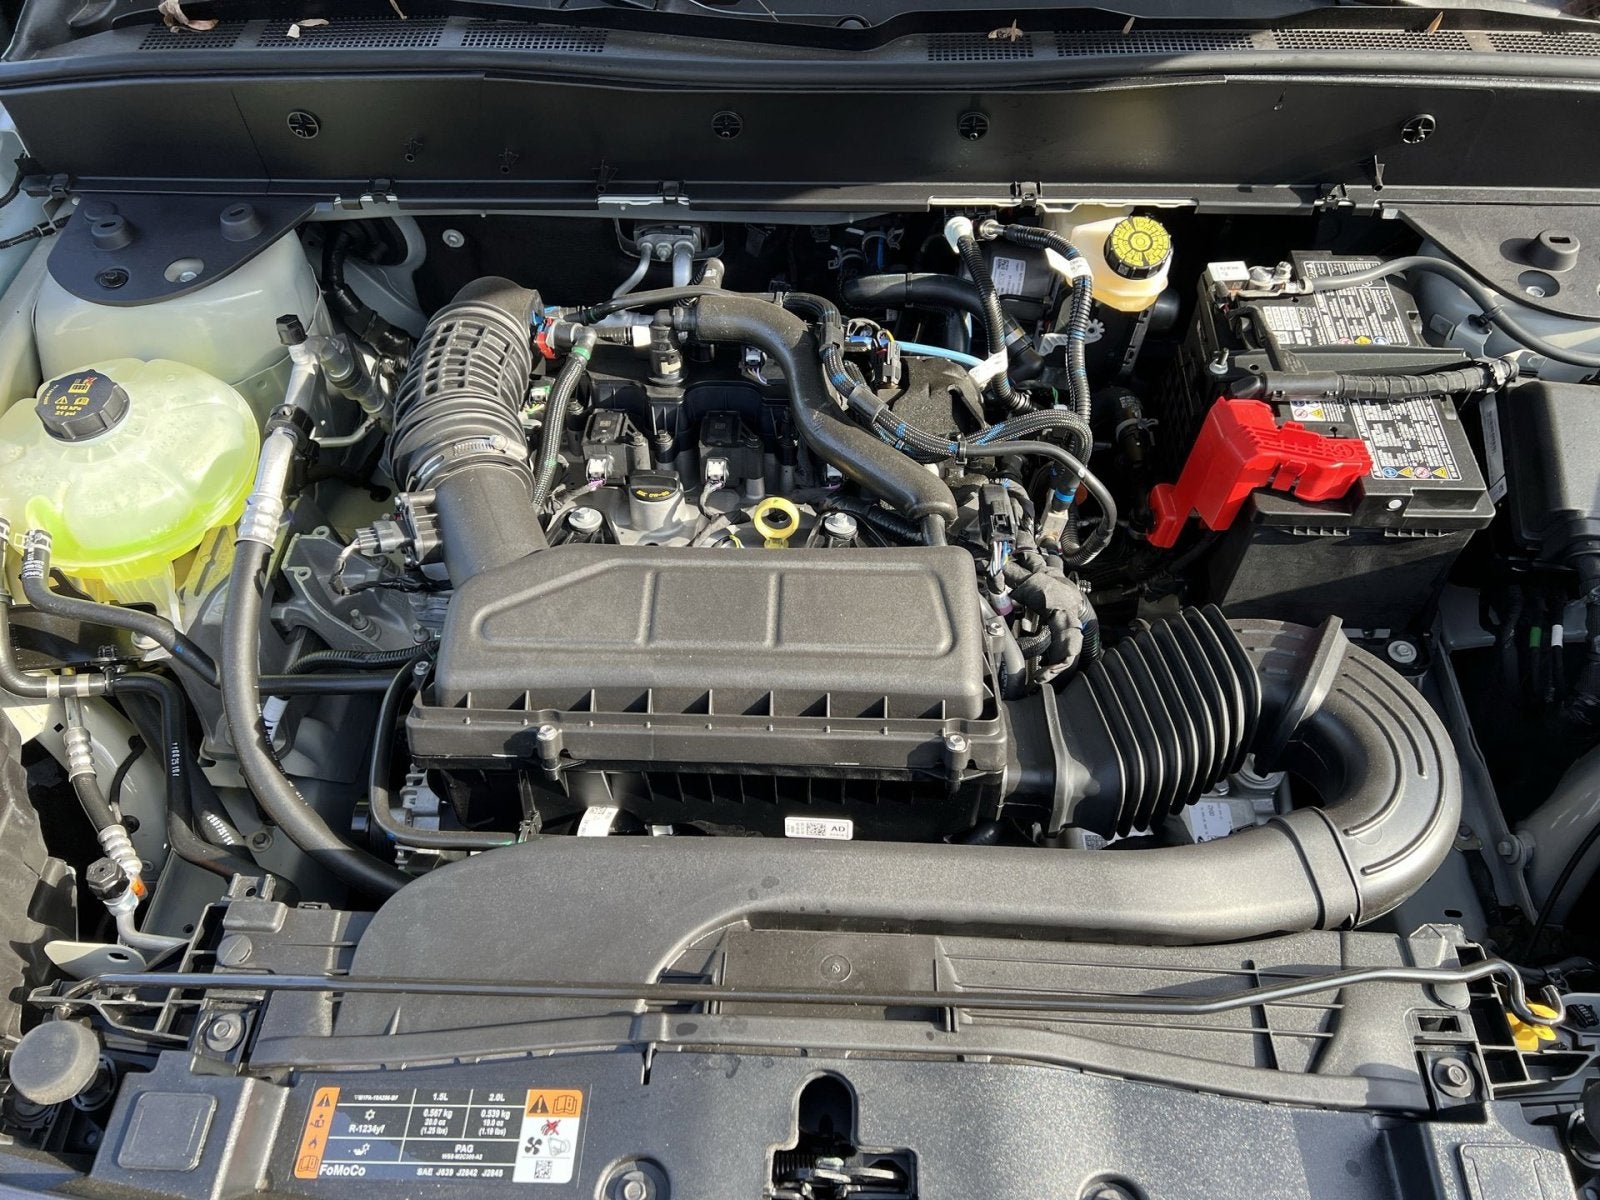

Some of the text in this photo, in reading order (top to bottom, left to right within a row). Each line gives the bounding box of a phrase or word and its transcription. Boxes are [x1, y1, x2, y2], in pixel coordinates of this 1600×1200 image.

[432, 1092, 448, 1101] 1.5L
[488, 1093, 505, 1102] 2.0L
[443, 1108, 453, 1119] kg
[501, 1109, 511, 1120] kg
[348, 1124, 386, 1135] R-1234yf
[454, 1144, 474, 1153] PAG
[319, 1163, 366, 1177] FoMoCo
